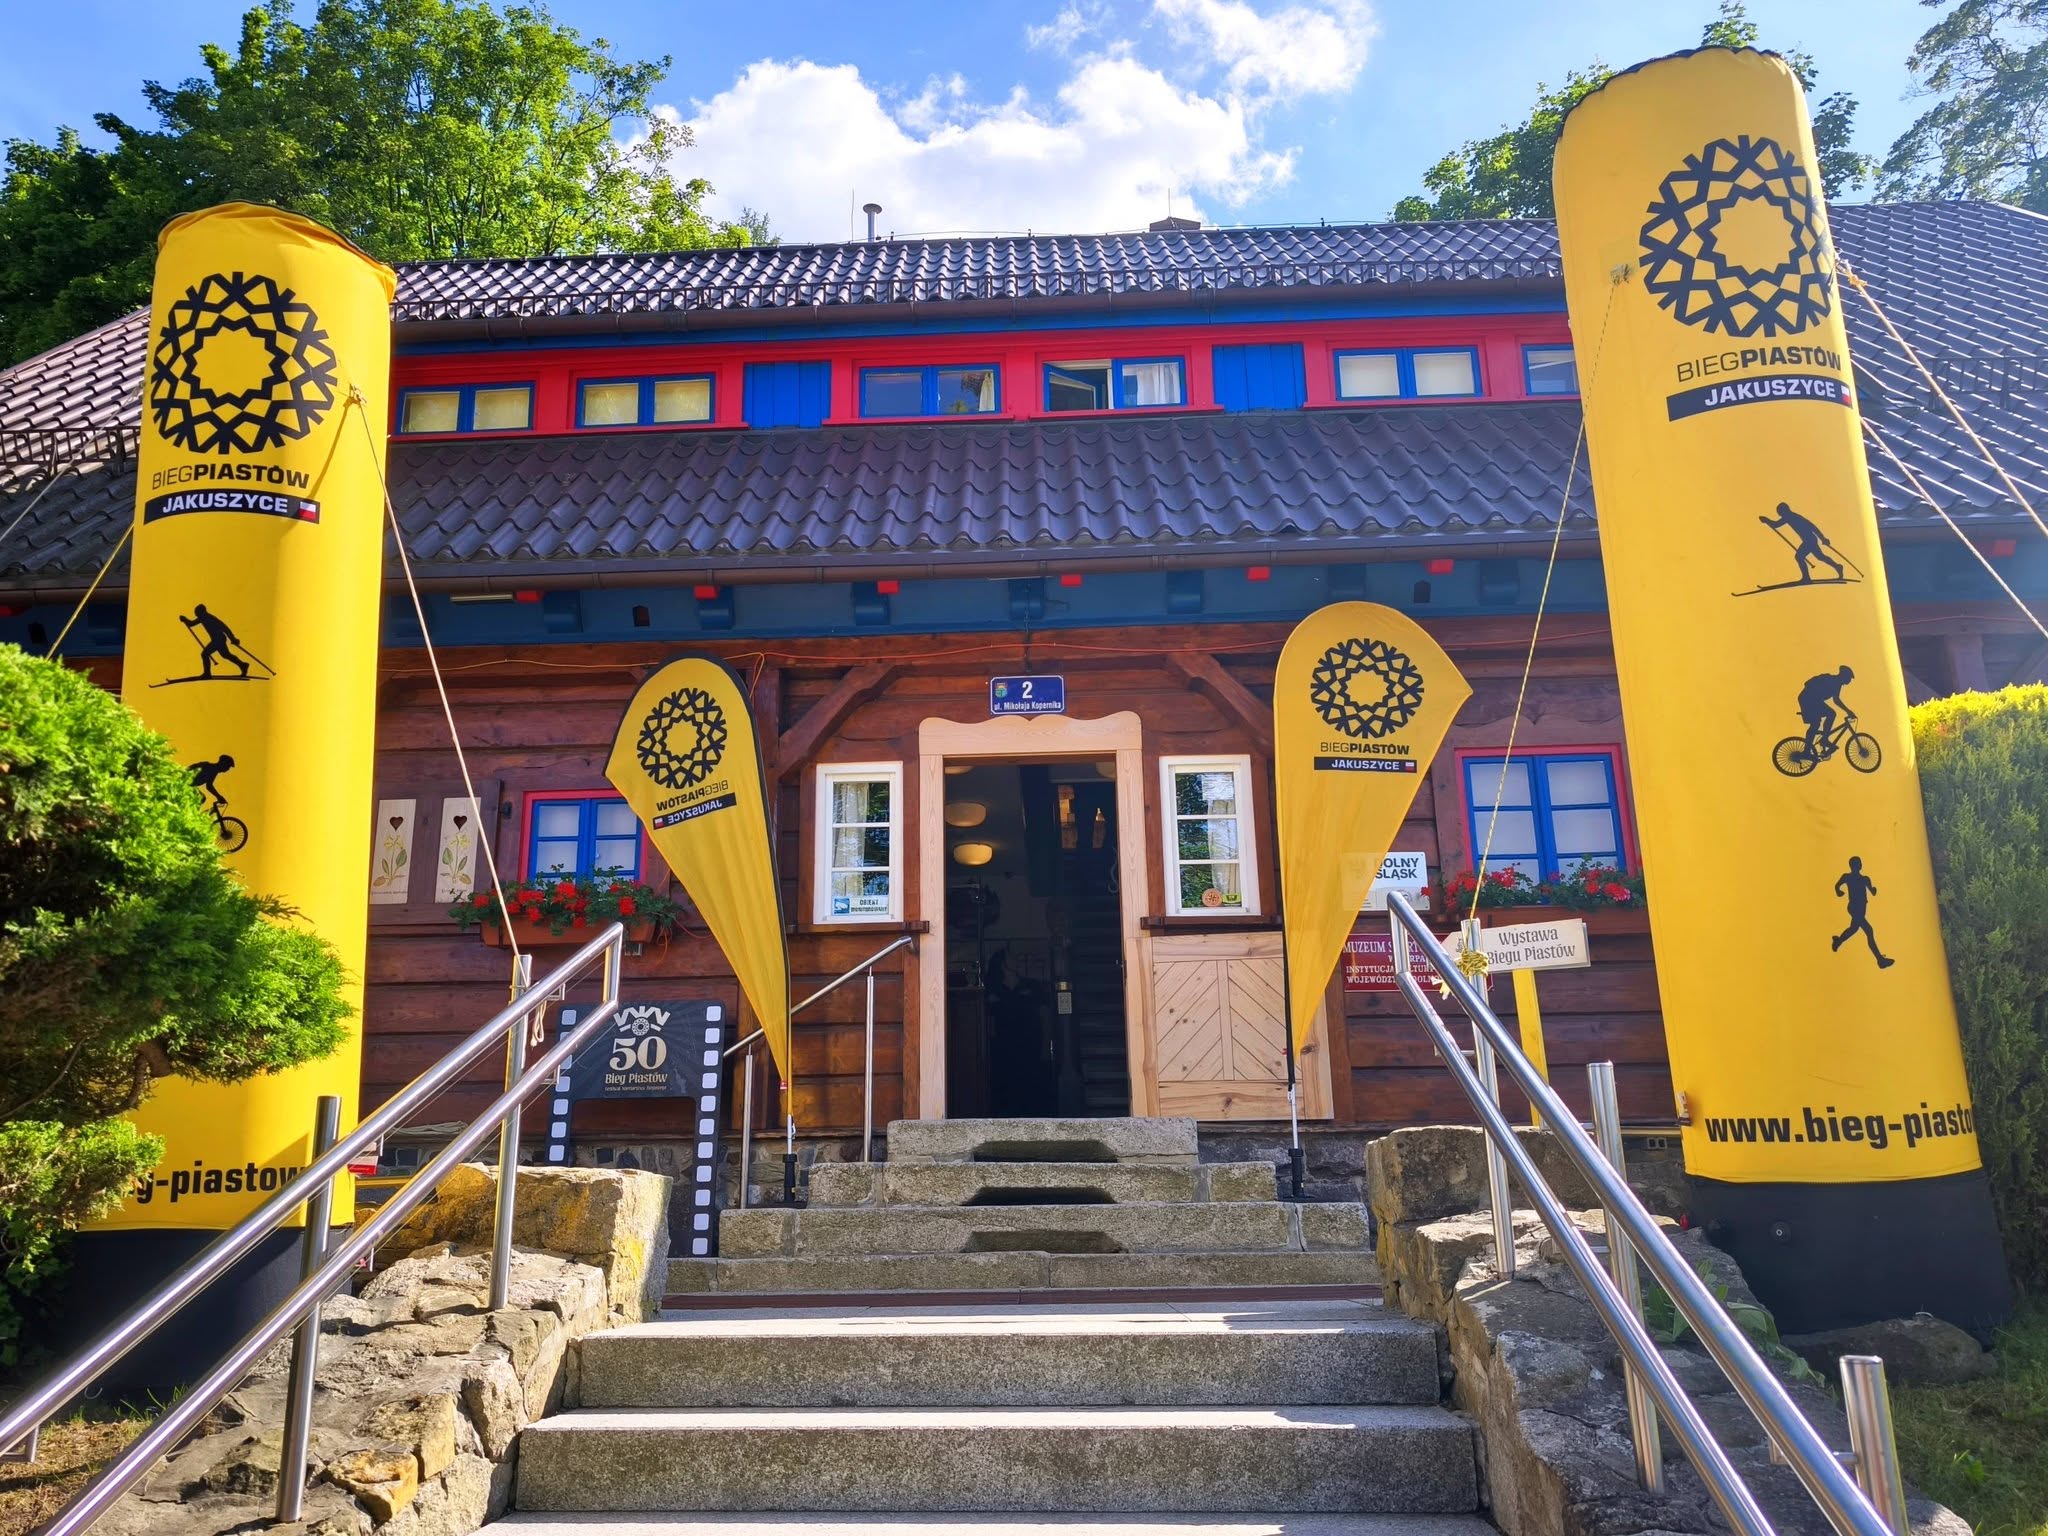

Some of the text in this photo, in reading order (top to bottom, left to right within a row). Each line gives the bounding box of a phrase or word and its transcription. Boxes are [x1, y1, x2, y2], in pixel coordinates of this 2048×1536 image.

[1705, 379, 1836, 406] JAKUSZYCE
[162, 493, 288, 513] JAKUSZYCE
[1022, 681, 1033, 699] 2
[1003, 702, 1030, 712] Mikołaja
[1031, 701, 1061, 711] Kopernika
[1331, 759, 1400, 770] JAKUSZYCE
[1379, 858, 1419, 868] OLNY
[1498, 928, 1558, 947] Wystawa
[1342, 941, 1386, 953] MUZEUM
[1487, 944, 1576, 965] Biegu Piastów
[1345, 965, 1394, 973] INSTYTUCJA
[609, 1036, 667, 1071] 50
[604, 1072, 668, 1085] Bieg Piastów
[1705, 1102, 1975, 1149] www.bieg-piasto
